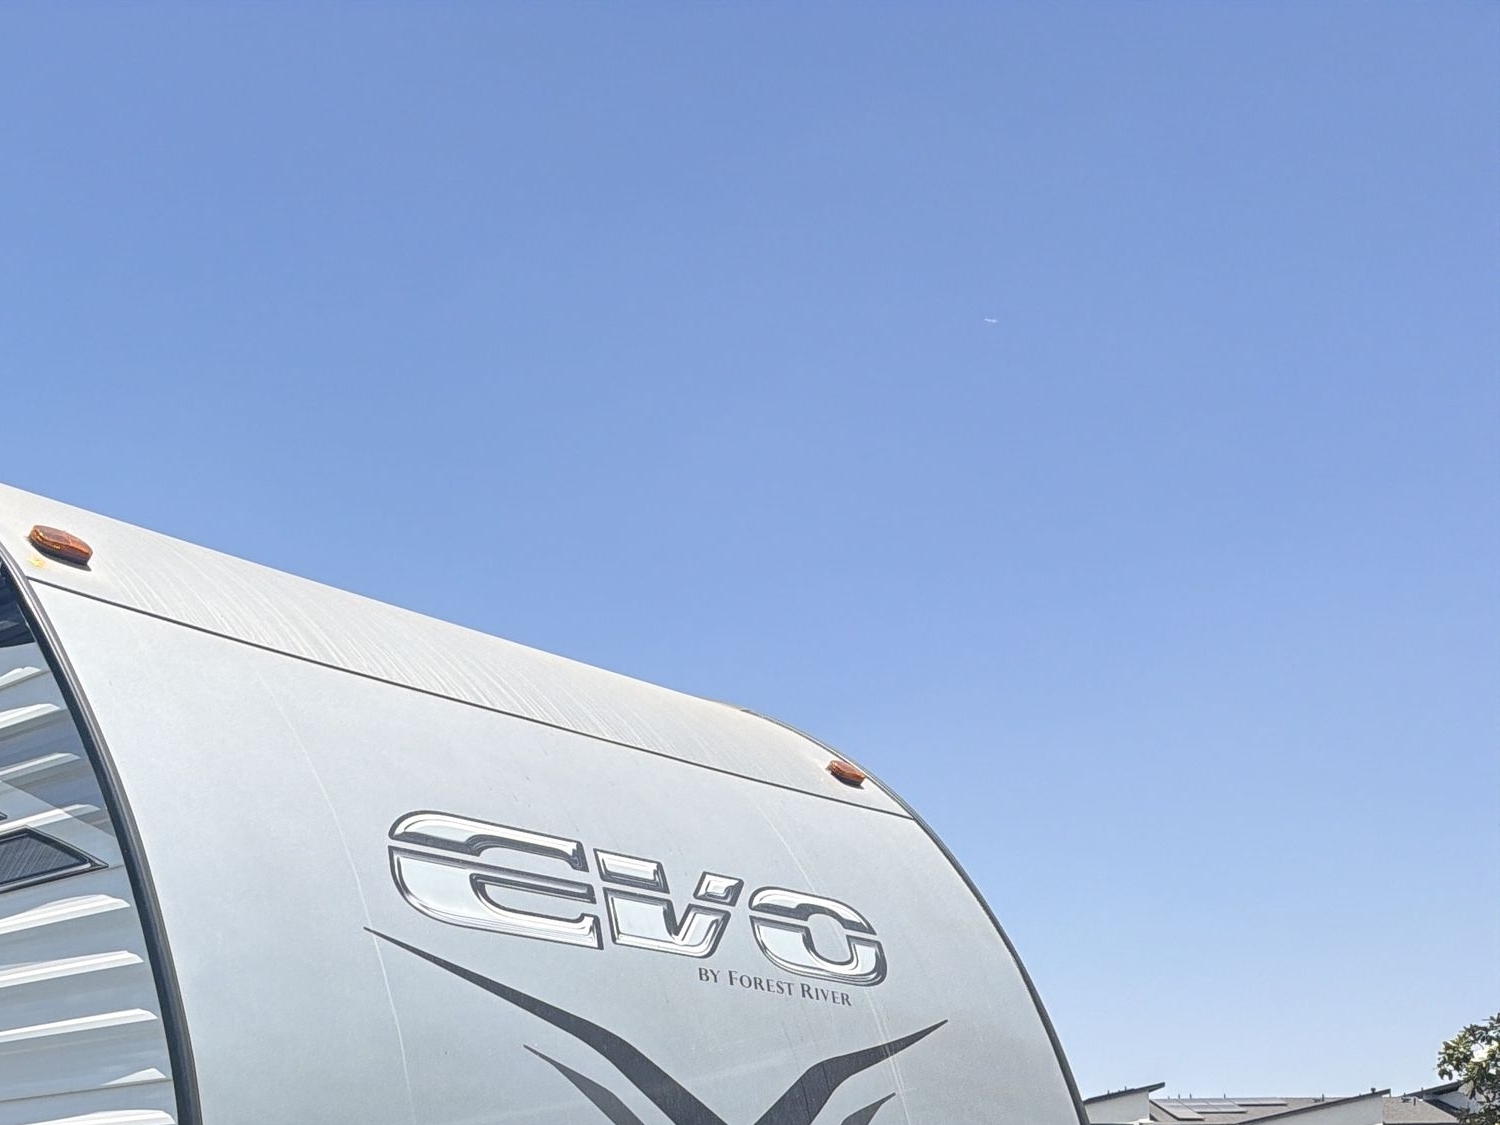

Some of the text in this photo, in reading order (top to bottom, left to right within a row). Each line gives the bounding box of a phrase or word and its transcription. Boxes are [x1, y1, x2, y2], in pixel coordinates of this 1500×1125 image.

[387, 810, 888, 987] EVO
[698, 967, 853, 1007] BY FOREST RIVER
